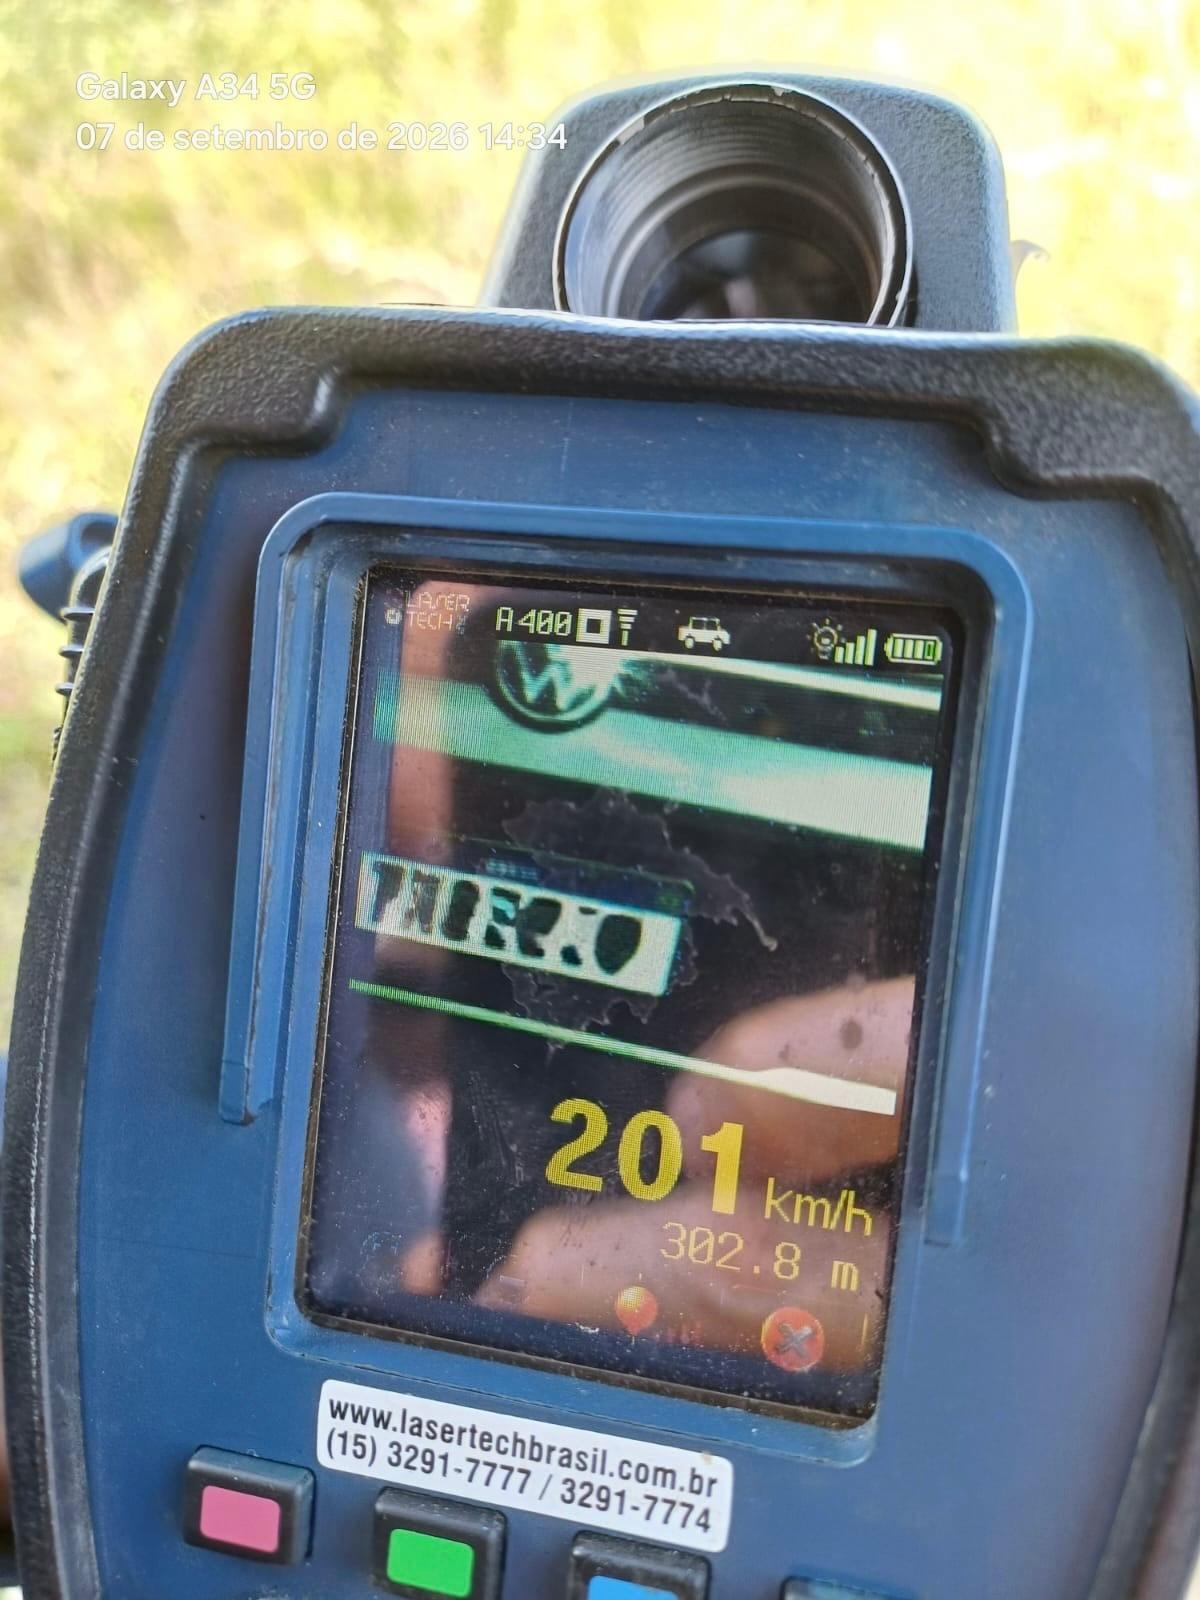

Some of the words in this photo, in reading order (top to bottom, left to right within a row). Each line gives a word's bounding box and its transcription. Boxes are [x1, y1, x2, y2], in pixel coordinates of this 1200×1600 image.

[544, 1097, 745, 1215] 201
[764, 1176, 874, 1237] km/h
[659, 1221, 802, 1281] 302.8
[831, 1259, 860, 1292] m
[326, 1428, 378, 1468] (15)
[387, 1444, 532, 1494] 3291-7777
[559, 1477, 711, 1533] 3291-7774
[328, 1398, 719, 1499] www.lasertechbrasil.com.br
